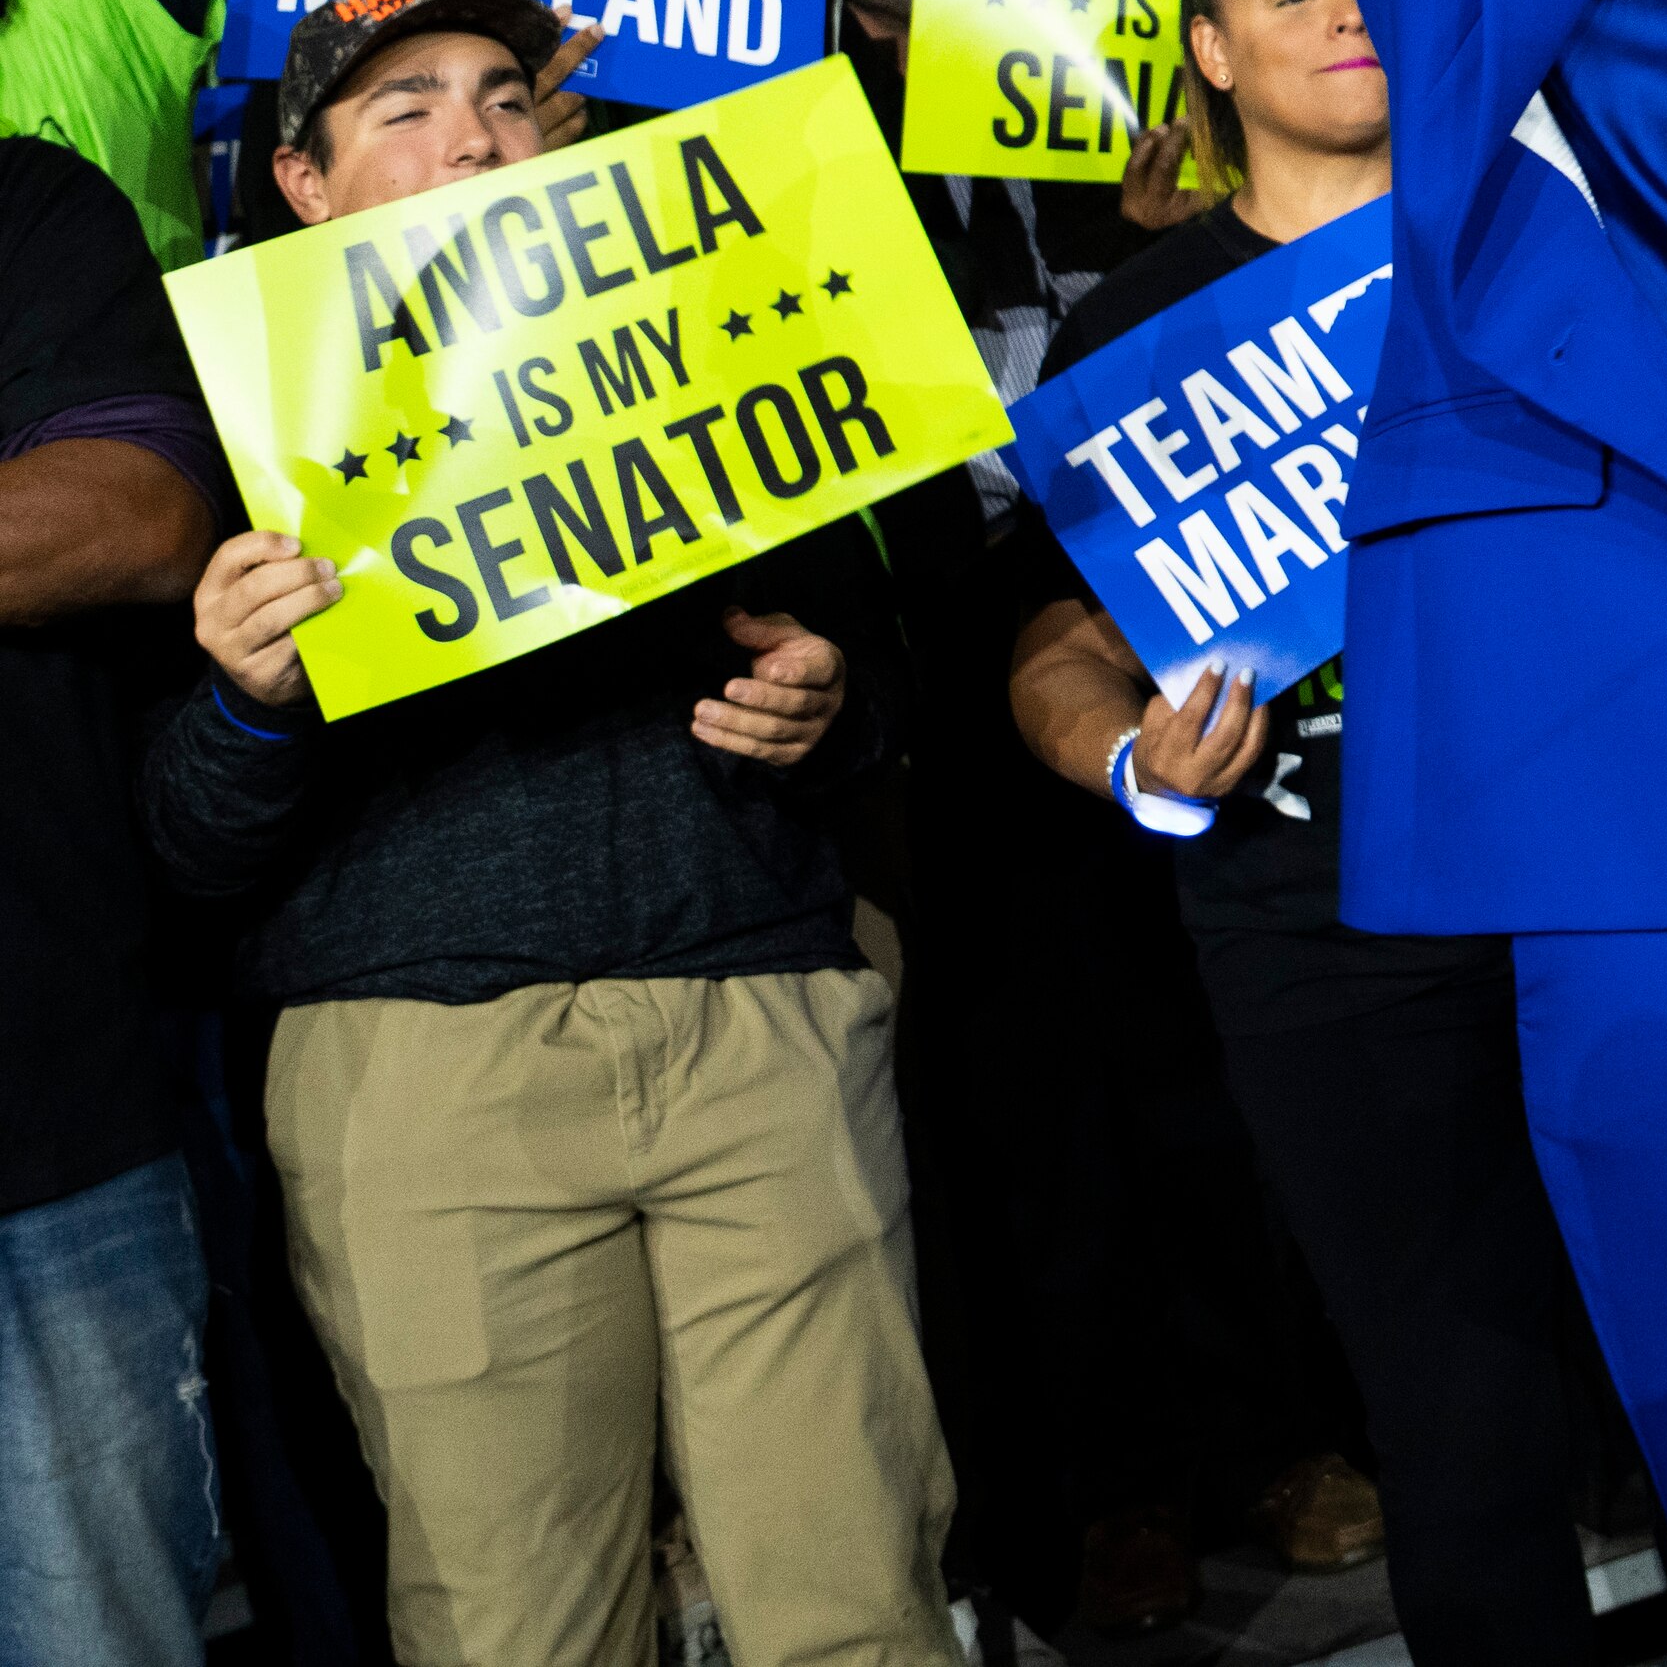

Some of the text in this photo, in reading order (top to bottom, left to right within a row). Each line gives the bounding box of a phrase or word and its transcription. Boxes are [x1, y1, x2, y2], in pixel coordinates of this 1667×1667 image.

[343, 133, 766, 374] ANGELA
[493, 307, 690, 449] IS MY
[1064, 315, 1354, 530] TEAM
[389, 355, 897, 644] SENATOR
